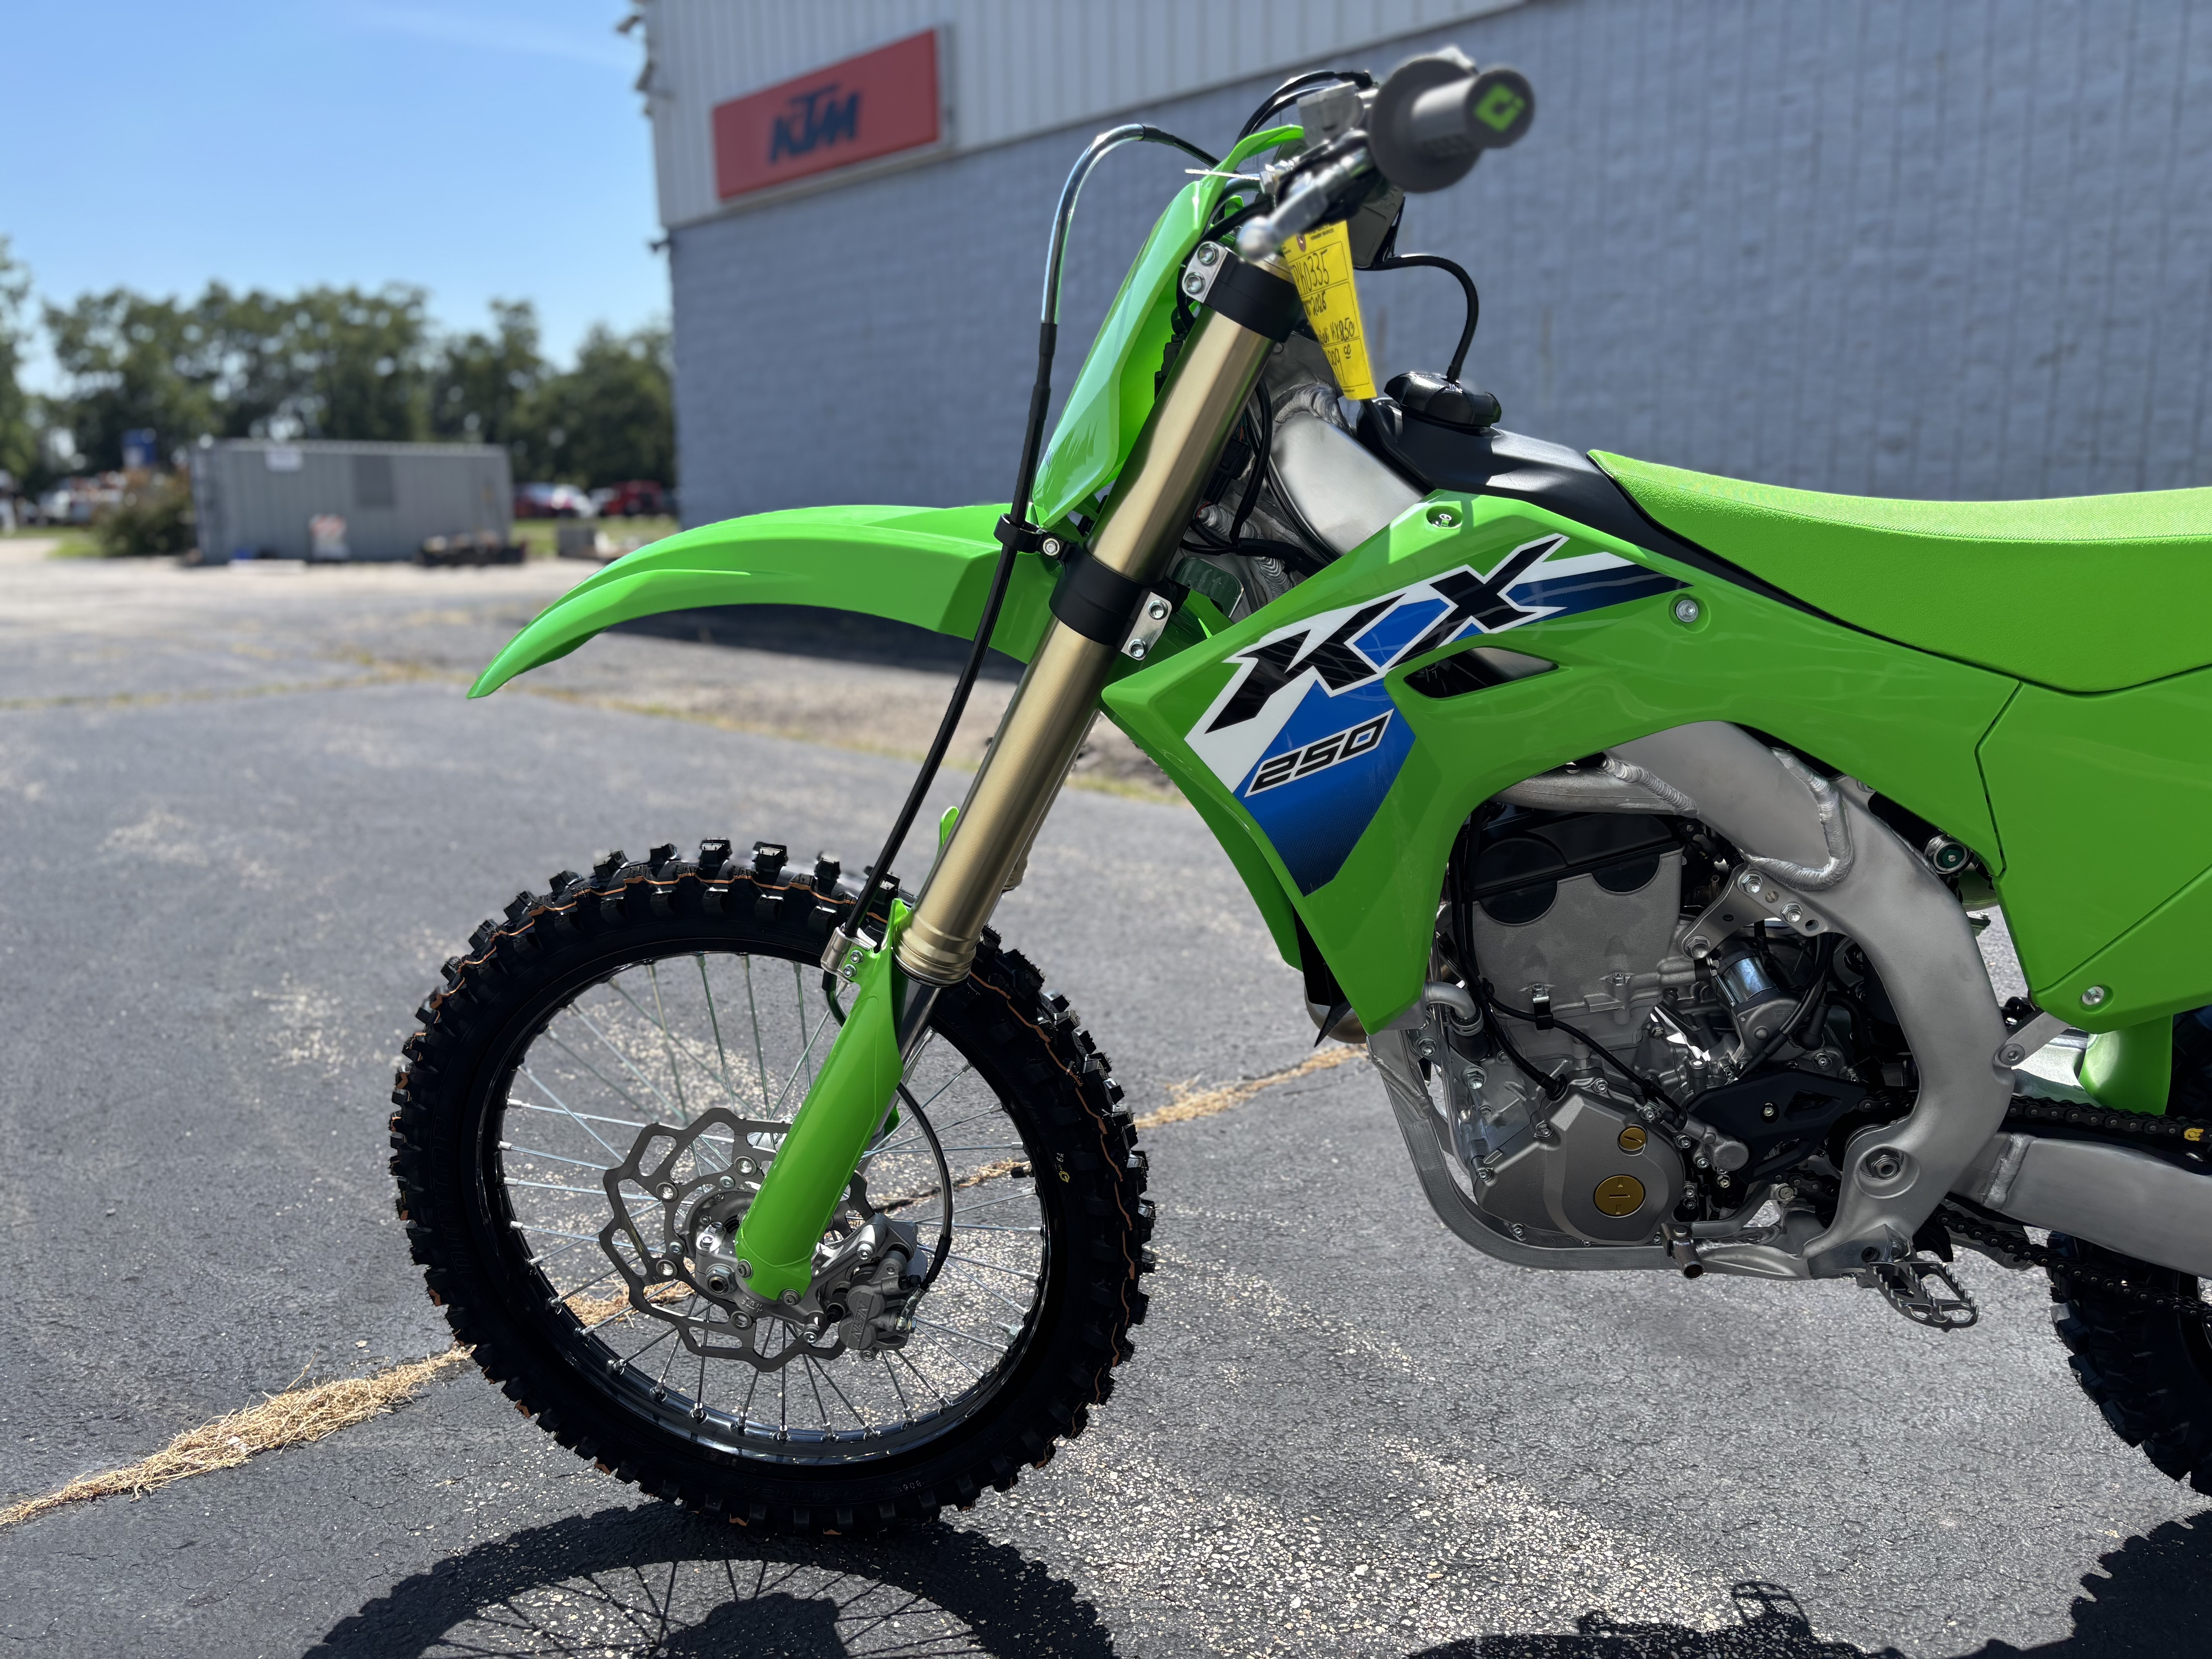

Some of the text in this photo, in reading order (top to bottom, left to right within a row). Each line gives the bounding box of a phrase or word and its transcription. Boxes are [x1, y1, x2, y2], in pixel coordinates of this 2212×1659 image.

[769, 82, 862, 165] KTM
[1204, 535, 1564, 735] KX
[1245, 711, 1393, 796] 250
